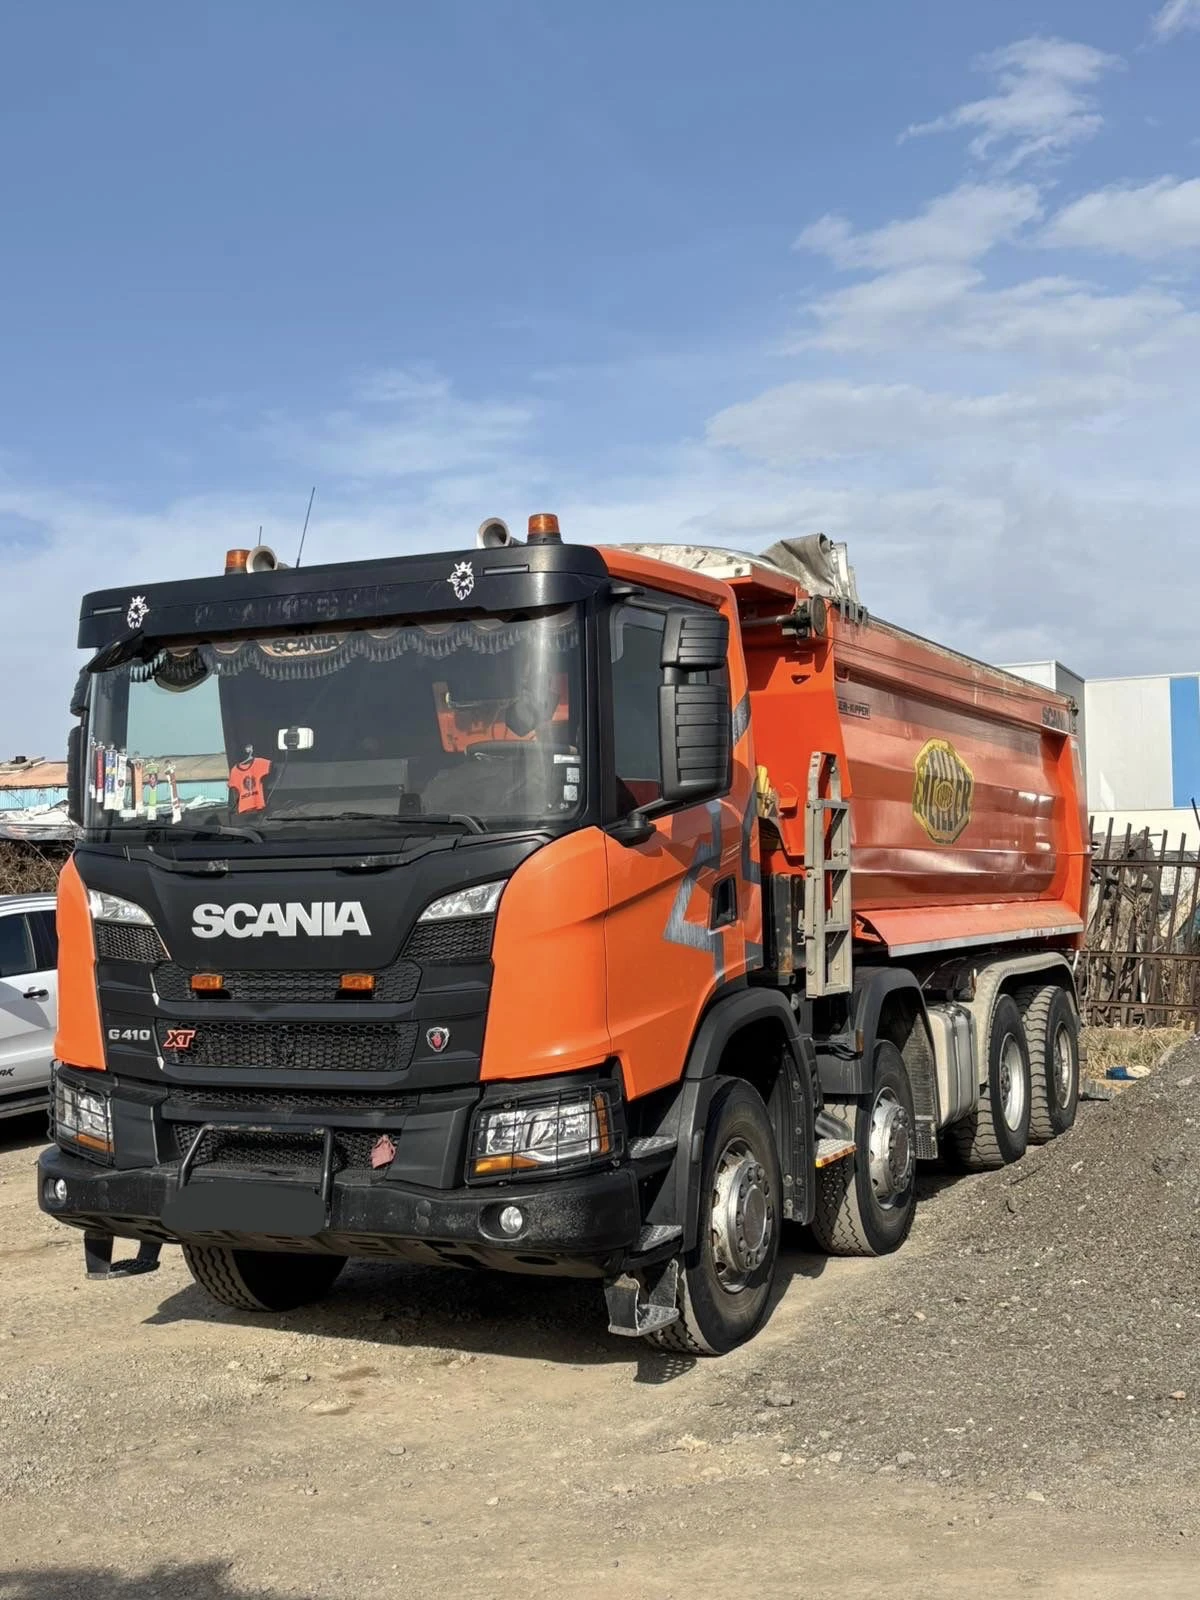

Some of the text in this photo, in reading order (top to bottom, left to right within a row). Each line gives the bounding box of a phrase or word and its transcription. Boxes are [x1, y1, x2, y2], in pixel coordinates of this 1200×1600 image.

[271, 635, 339, 653] SCANIA
[191, 901, 372, 938] SCANIA
[108, 1029, 151, 1041] G410
[163, 1029, 196, 1048] XT
